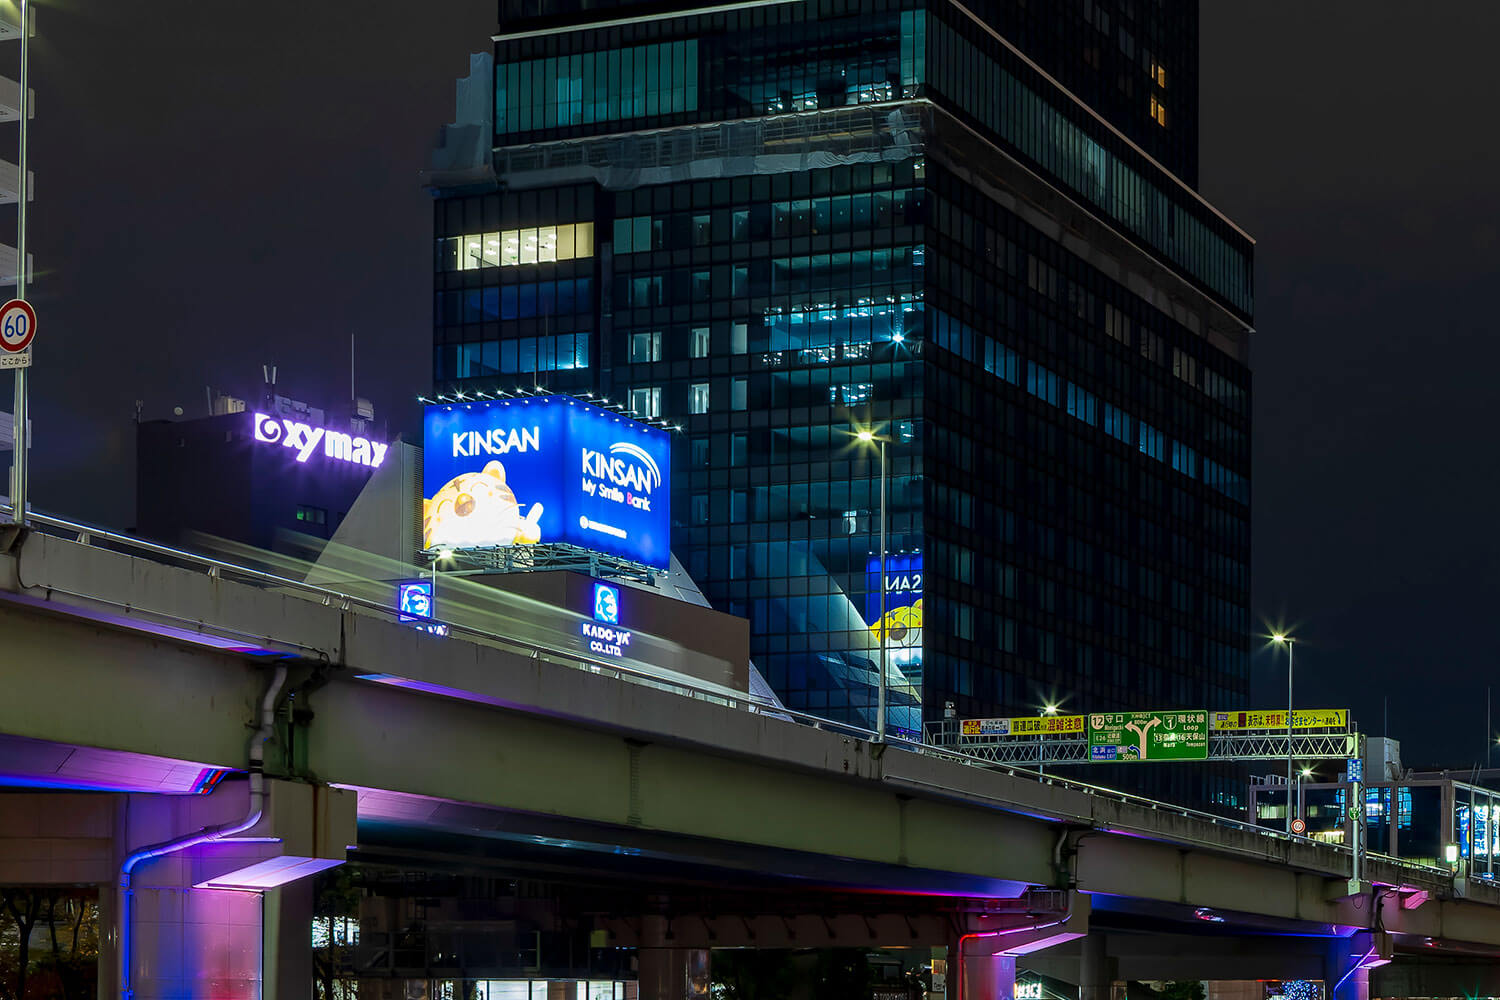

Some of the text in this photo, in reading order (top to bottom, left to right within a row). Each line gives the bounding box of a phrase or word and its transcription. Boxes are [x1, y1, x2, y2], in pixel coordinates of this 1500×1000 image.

[5, 314, 26, 338] 60
[2, 356, 28, 366] ここから
[453, 426, 539, 457] KINSAN
[582, 448, 651, 494] KINSAN
[582, 477, 651, 511] My Smile Bank
[1092, 716, 1104, 727] 12
[1105, 714, 1124, 723] 守口
[1178, 714, 1205, 723] 環状線
